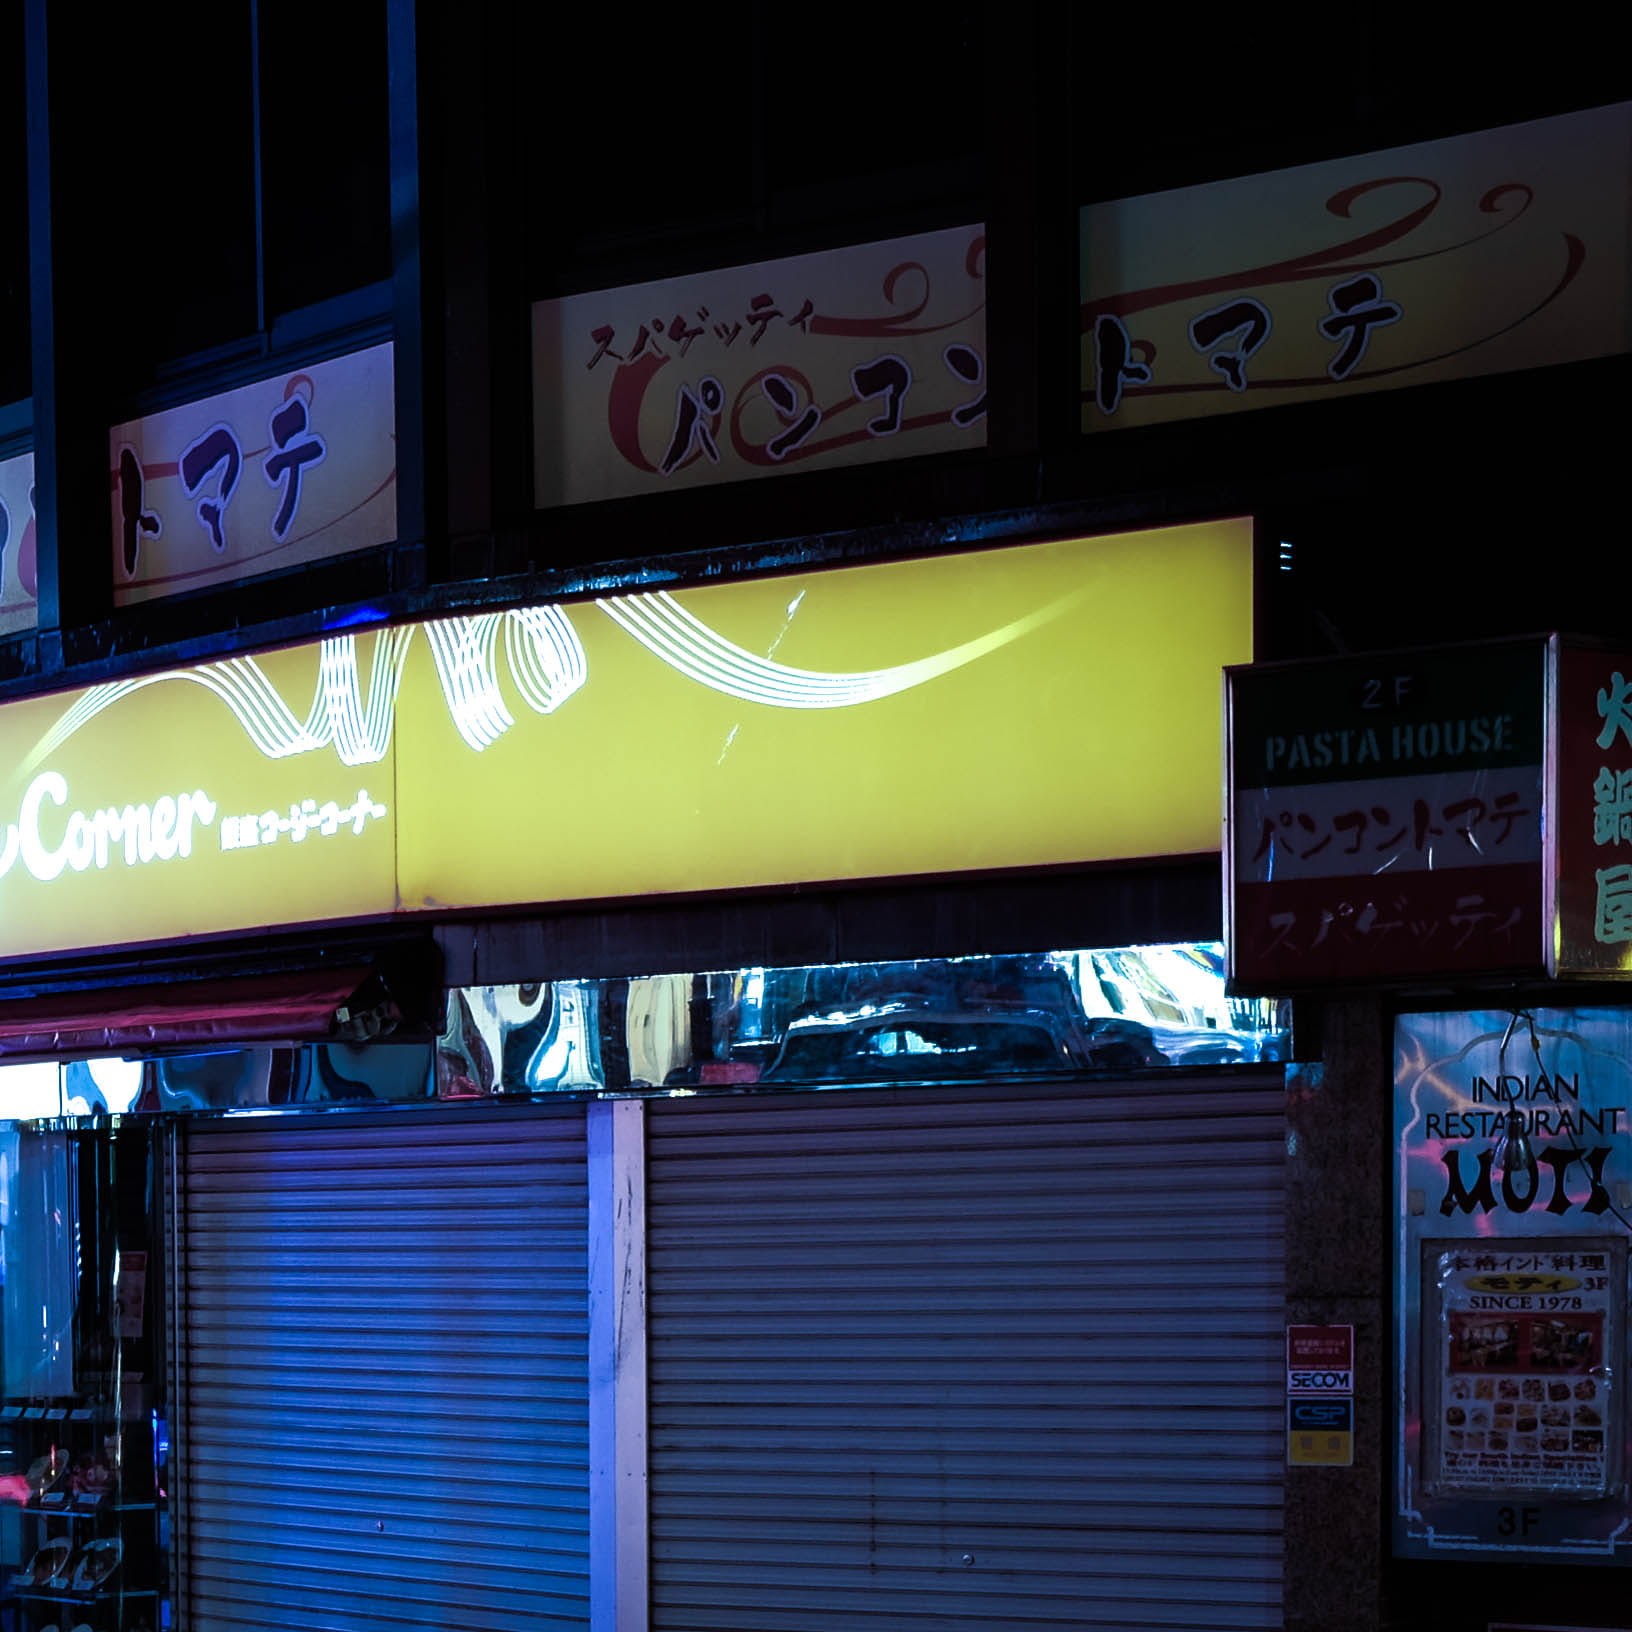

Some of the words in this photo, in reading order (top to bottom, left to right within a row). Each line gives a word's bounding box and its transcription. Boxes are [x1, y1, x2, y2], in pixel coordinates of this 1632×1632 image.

[587, 294, 813, 370] スパゲッティ
[1094, 273, 1402, 414] トマテ
[119, 374, 327, 579] トマテ
[1265, 727, 1382, 770] PASTA
[1392, 715, 1514, 760] HOUSE
[17, 771, 217, 881] Corner
[1251, 791, 1531, 863] パンコントマテ
[1472, 1074, 1579, 1104] INDIAN
[1426, 1107, 1625, 1140] RESTAURANT
[1454, 1254, 1608, 1272] 本格インド料理
[1584, 1276, 1609, 1291] 3F
[1470, 1296, 1533, 1310] SINCE
[1539, 1296, 1583, 1310] 1978
[1291, 1372, 1349, 1388] SECOM
[1294, 1404, 1347, 1421] CSP
[1497, 1506, 1542, 1538] 3F
